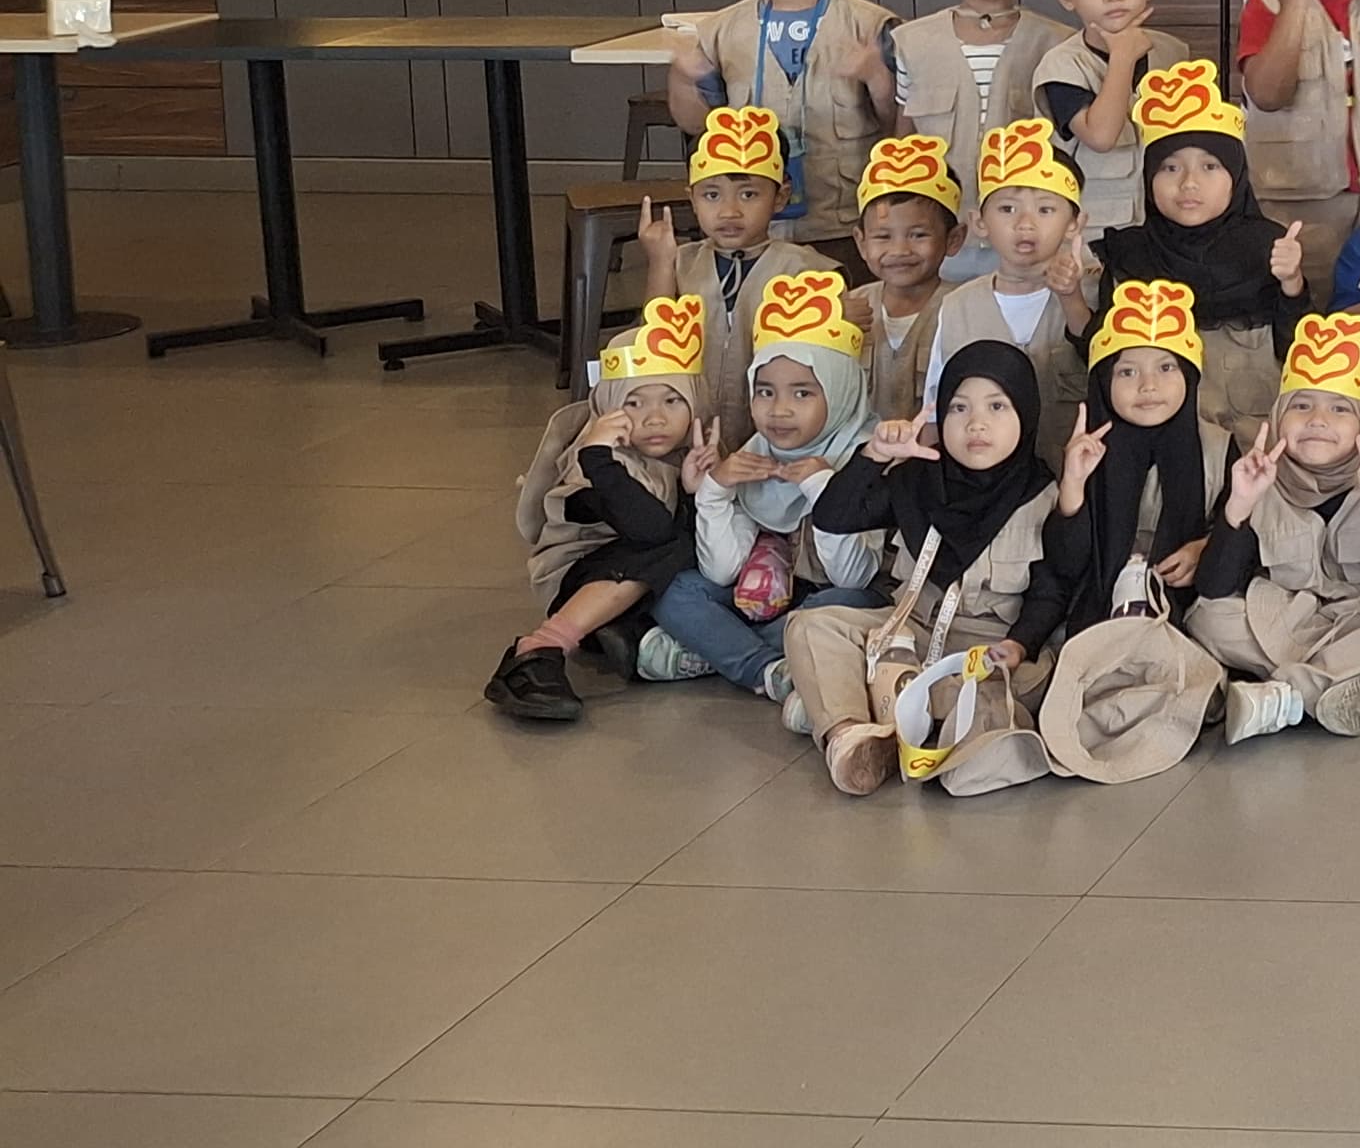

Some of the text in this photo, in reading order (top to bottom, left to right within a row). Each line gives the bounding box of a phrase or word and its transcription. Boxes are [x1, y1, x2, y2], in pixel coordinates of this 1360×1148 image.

[908, 554, 931, 592] HAPPY
[927, 590, 958, 665] HAPPY BABY
